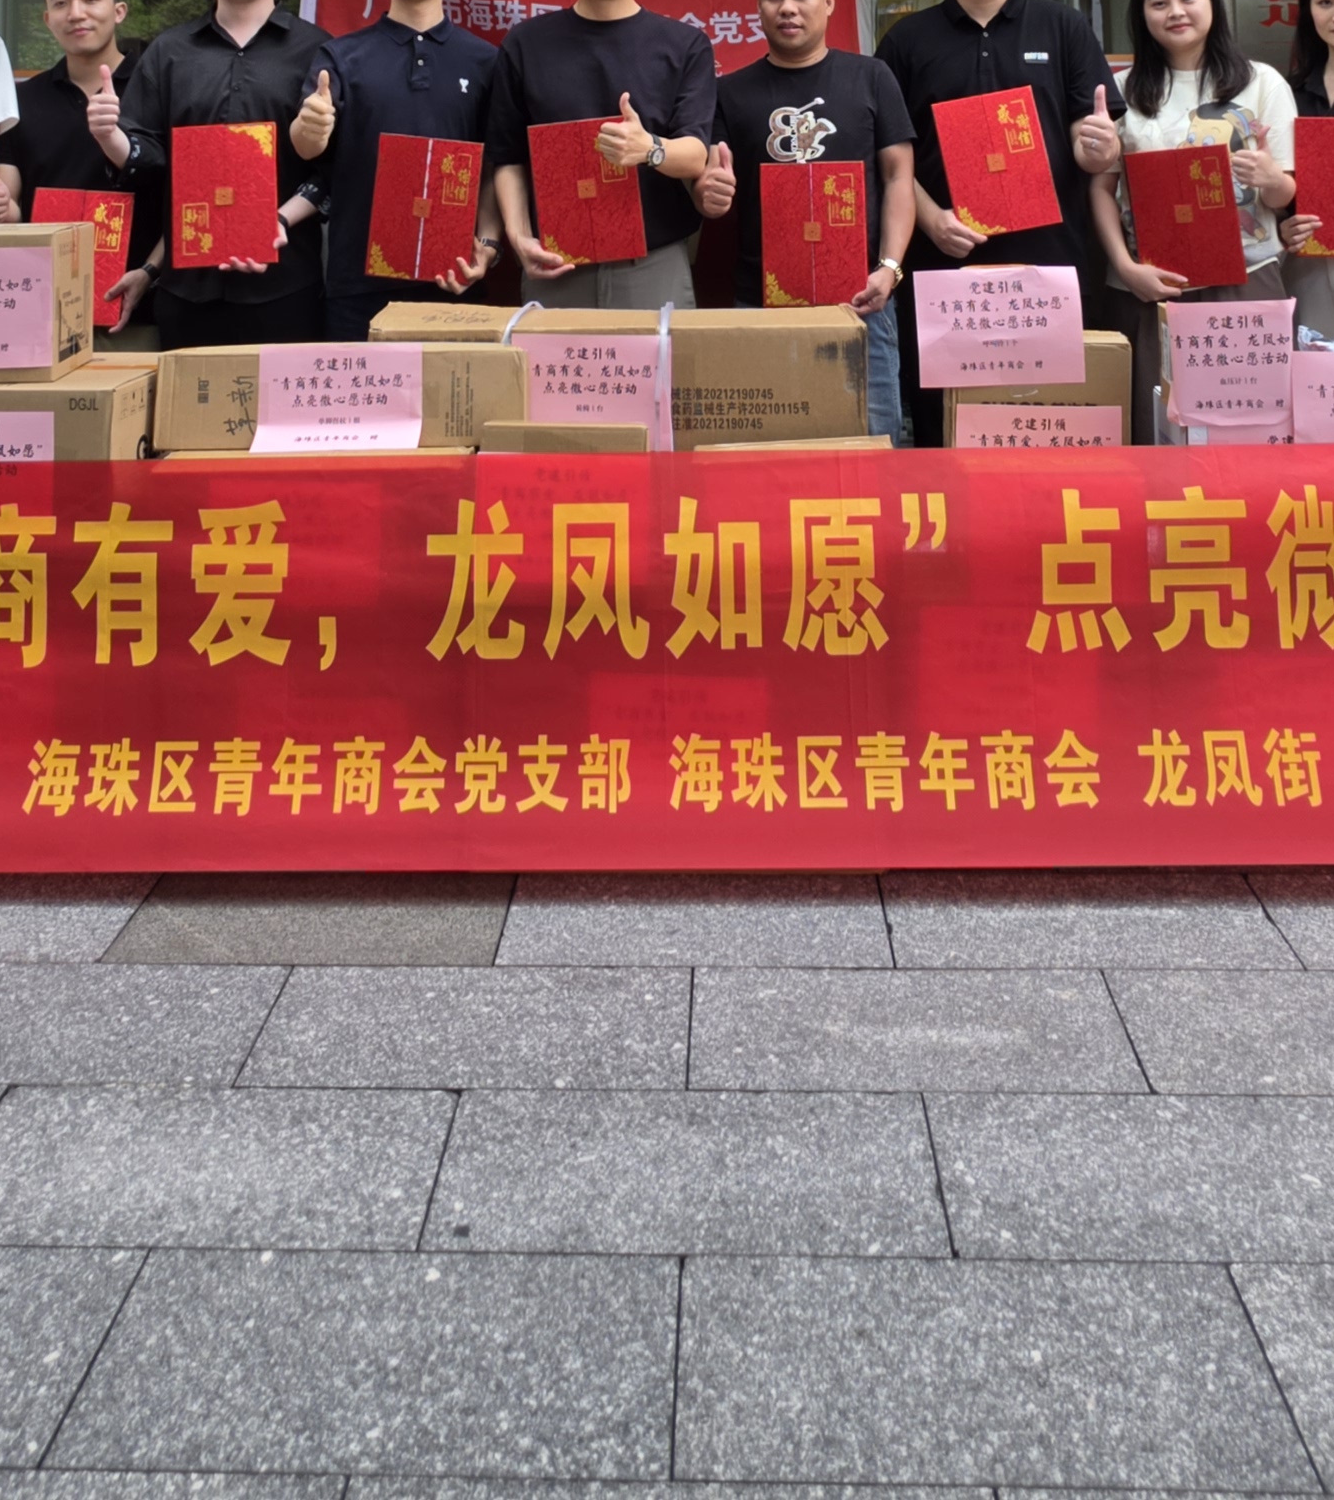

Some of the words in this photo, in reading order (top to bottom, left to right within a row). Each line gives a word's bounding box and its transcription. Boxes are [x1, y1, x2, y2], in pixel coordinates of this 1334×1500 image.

[969, 280, 1024, 294] 党建引领
[951, 315, 1048, 331] 点亮微心愿活动
[1207, 315, 1264, 330] 党建引领
[564, 347, 617, 360] 党建引领
[1186, 351, 1289, 367] 点亮微心愿活动
[313, 357, 367, 371] 党建引领
[960, 360, 1025, 371] 海珠区青年商会
[543, 381, 637, 395] 点亮微心愿活动
[69, 398, 99, 411] DGJL
[291, 393, 388, 408] 点亮微心愿活动
[1195, 399, 1265, 409] 海珠区青年商会
[1011, 417, 1066, 431] 党建引领
[21, 733, 634, 818] 海珠区青年商会党支部
[668, 729, 1101, 813] 海珠区青年商会
[1137, 727, 1324, 811] 龙凤街
